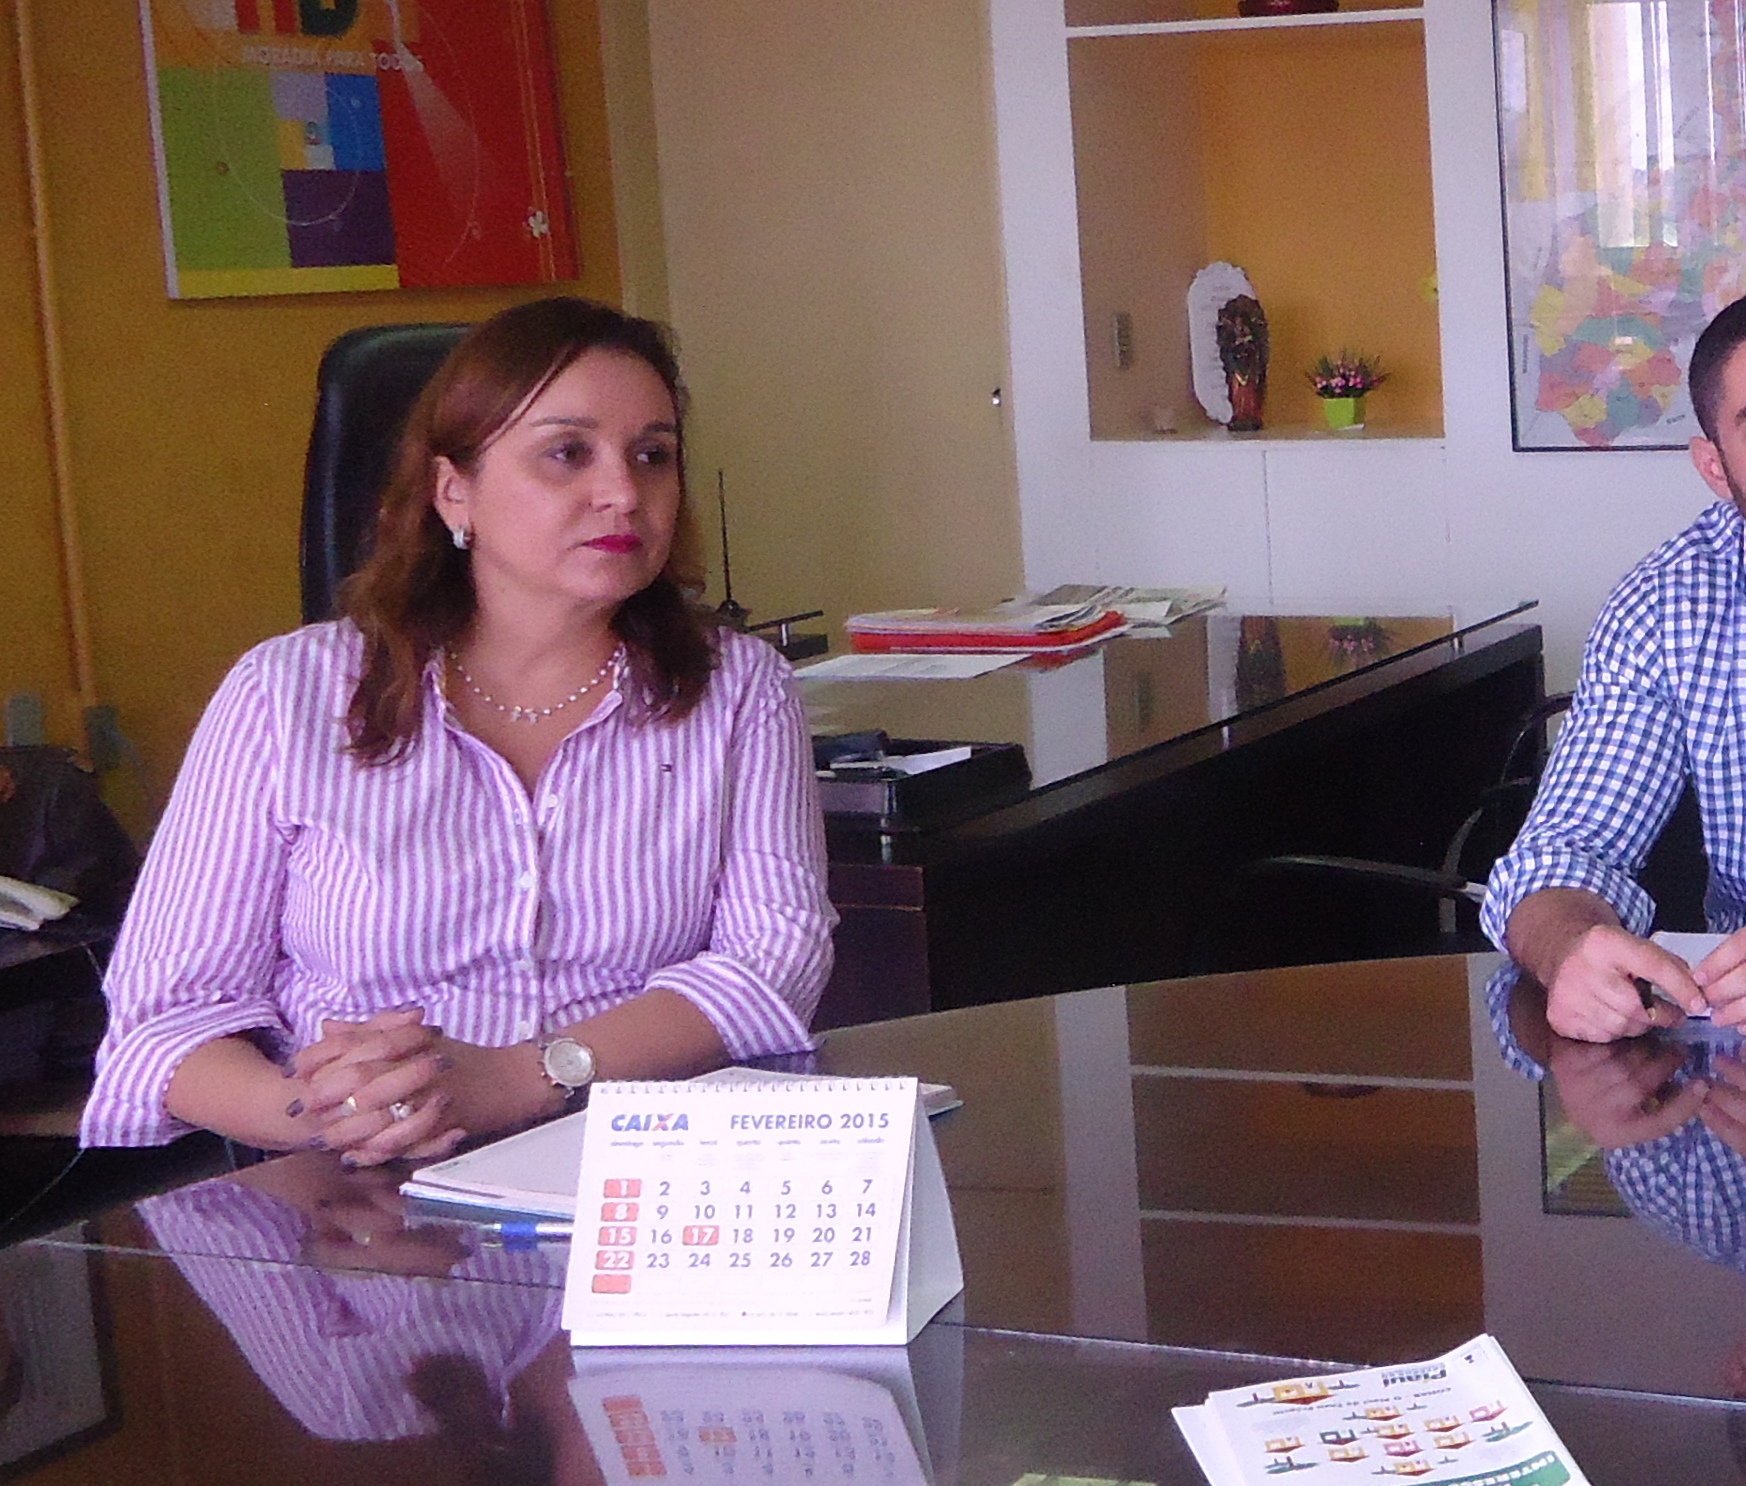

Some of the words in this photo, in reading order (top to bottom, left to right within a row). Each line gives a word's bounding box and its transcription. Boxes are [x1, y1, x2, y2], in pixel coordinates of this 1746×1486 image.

[611, 1113, 689, 1132] CAIXA
[730, 1113, 833, 1130] FEVEREIRO
[840, 1112, 889, 1129] 2015
[620, 1179, 626, 1197] 1
[659, 1180, 671, 1197] 2
[700, 1180, 711, 1196] 3
[739, 1180, 751, 1194] 4
[780, 1180, 792, 1196] 5
[821, 1180, 833, 1195] 6
[862, 1178, 873, 1194] 7
[616, 1203, 627, 1221] 8
[656, 1204, 669, 1220] 9
[694, 1204, 716, 1220] 10
[735, 1204, 753, 1219] 11
[775, 1203, 797, 1219] 12
[816, 1203, 837, 1219] 13
[856, 1202, 876, 1218] 14
[608, 1227, 631, 1245] 15
[651, 1228, 673, 1245] 16
[689, 1226, 712, 1244] 17
[733, 1227, 754, 1244] 18
[773, 1227, 796, 1243] 19
[812, 1226, 836, 1244] 20
[852, 1226, 872, 1242] 21
[605, 1251, 628, 1269] 22
[647, 1252, 670, 1269] 23
[688, 1252, 711, 1268] 24
[729, 1252, 751, 1268] 25
[770, 1252, 793, 1268] 26
[810, 1251, 834, 1268] 27
[850, 1250, 871, 1267] 28
